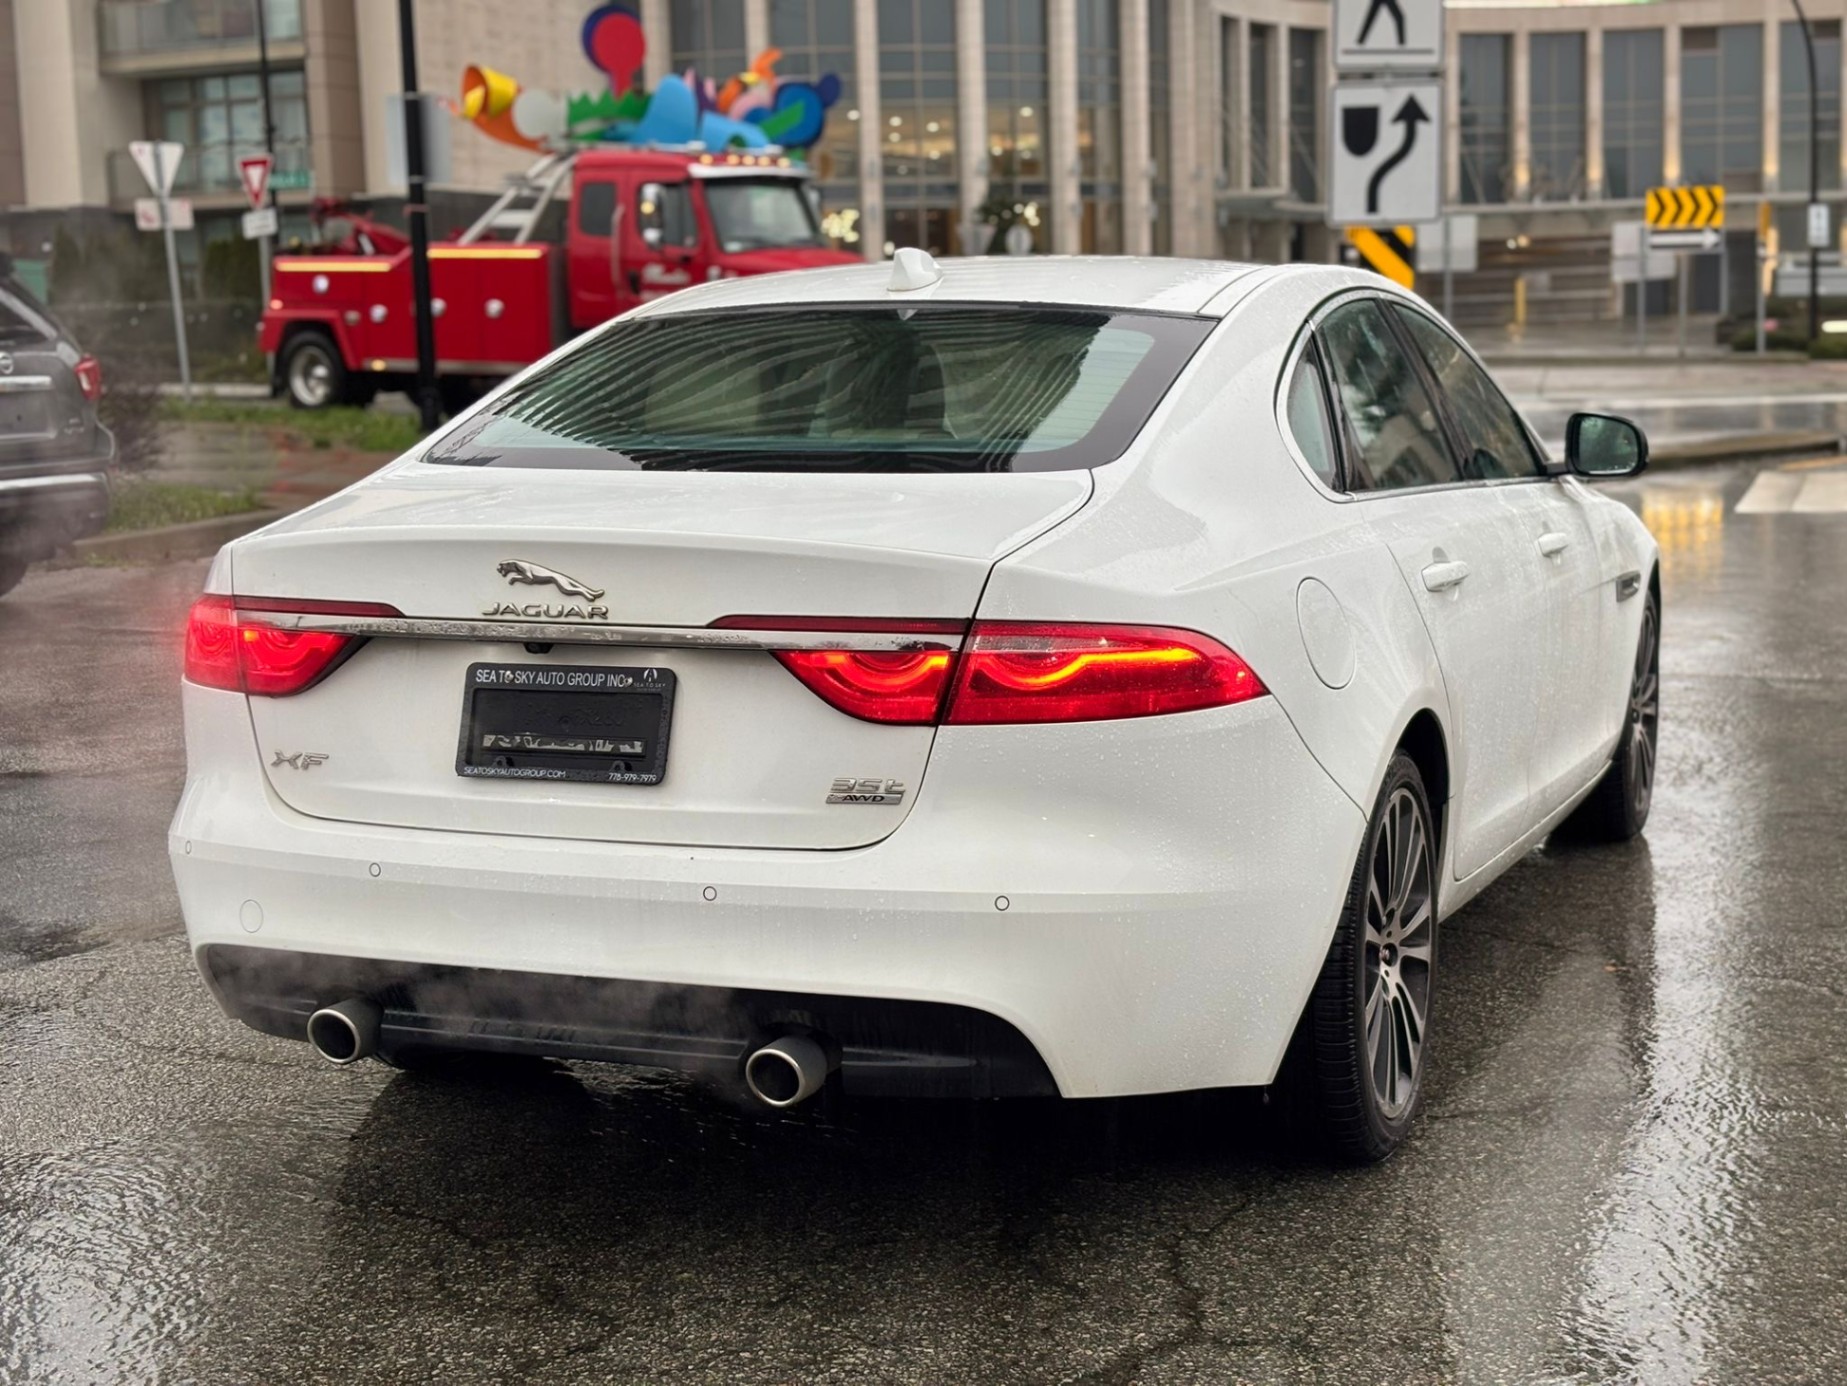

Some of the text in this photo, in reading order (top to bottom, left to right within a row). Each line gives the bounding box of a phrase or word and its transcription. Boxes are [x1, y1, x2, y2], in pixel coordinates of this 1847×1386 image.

[482, 602, 608, 619] JAGUAR
[475, 669, 497, 682] SEA
[514, 671, 536, 684] SKY
[536, 672, 565, 685] AUTO
[567, 672, 605, 686] GROUP
[271, 750, 330, 770] XF
[609, 773, 657, 782] 778-979-7979
[842, 794, 885, 802] AWD
